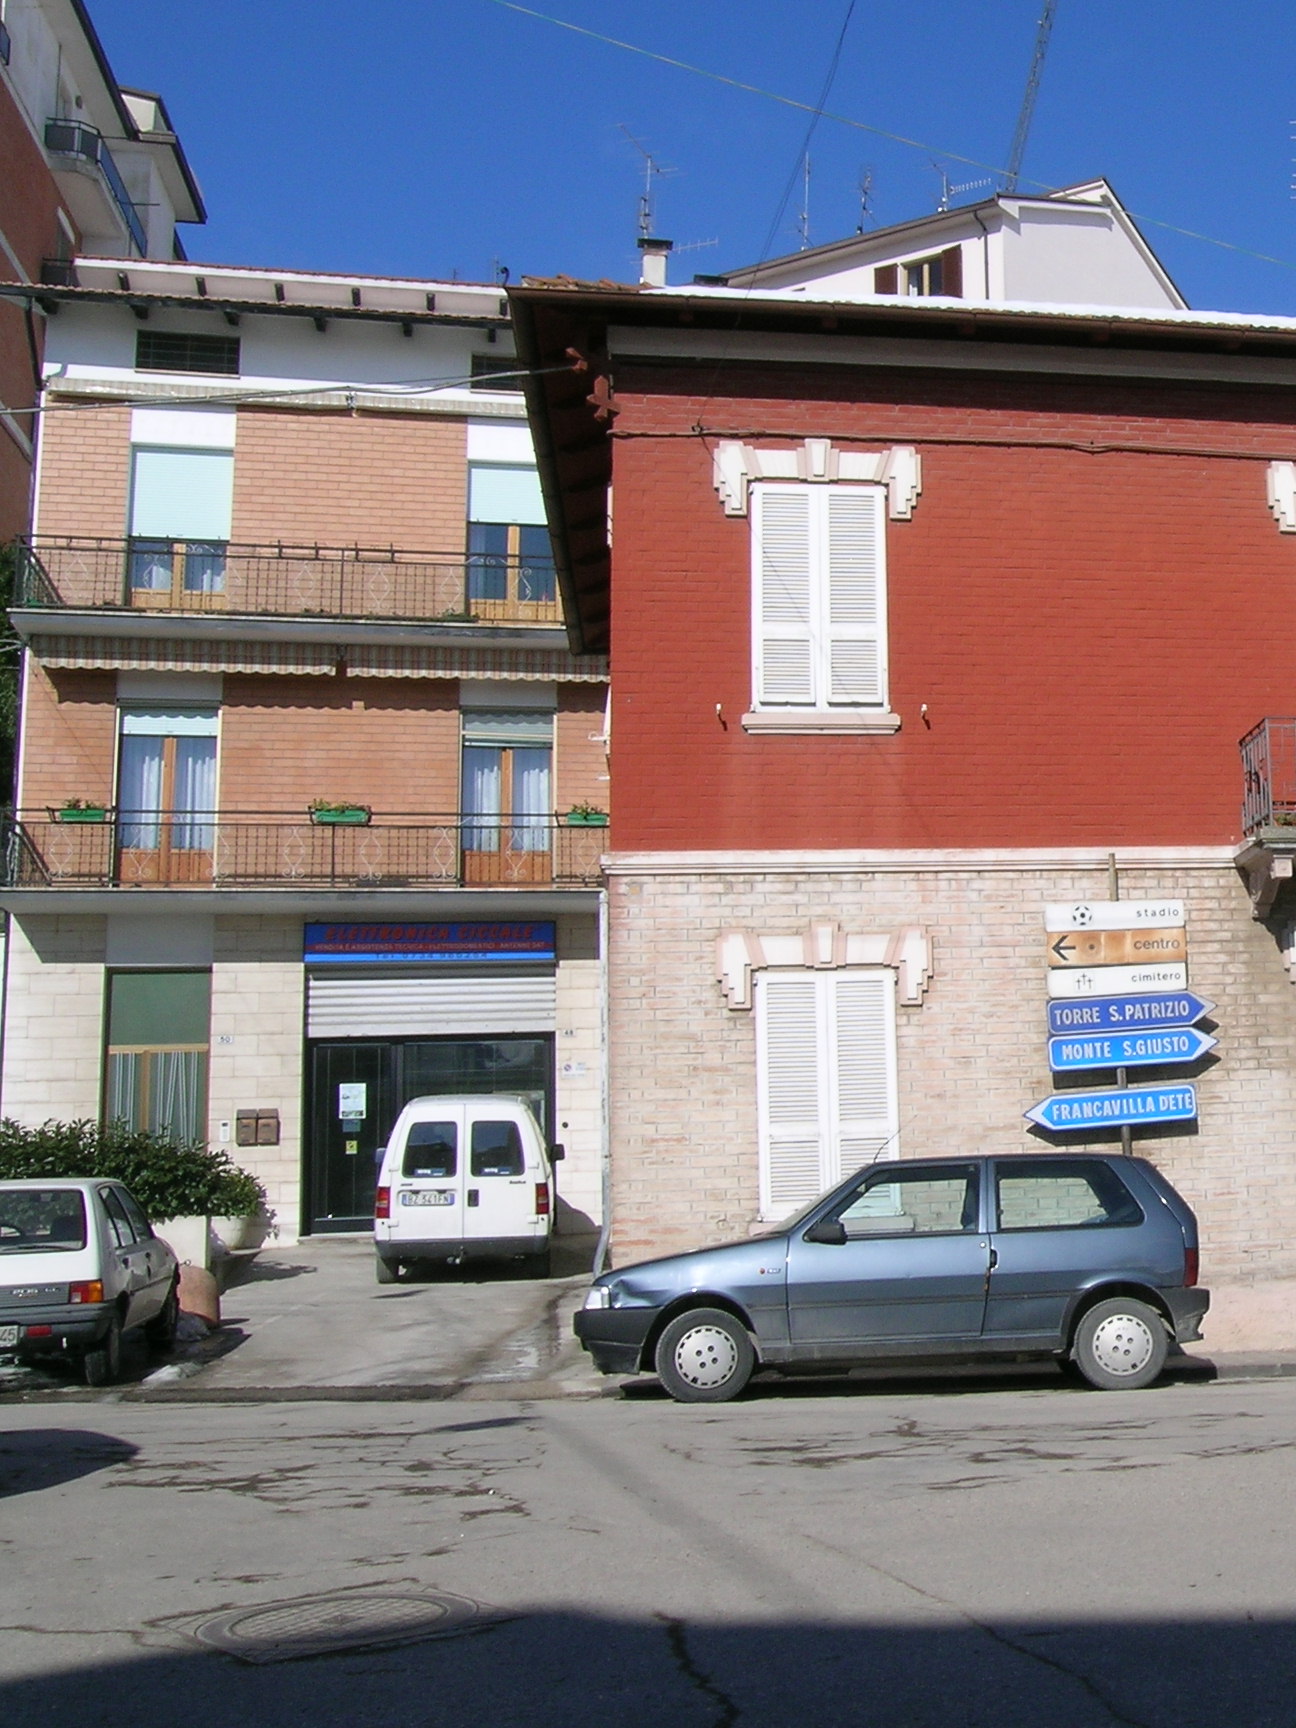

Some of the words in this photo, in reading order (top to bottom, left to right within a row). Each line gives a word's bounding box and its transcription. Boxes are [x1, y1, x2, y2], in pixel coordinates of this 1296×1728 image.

[1136, 907, 1179, 918] stadio
[326, 926, 448, 940] ELETTRONICA
[1133, 934, 1180, 949] centro
[1131, 971, 1181, 983] cimitero
[1054, 1006, 1101, 1026] TORRE
[1109, 1000, 1190, 1022] S.PATRIZIO
[1062, 1041, 1112, 1060] MONTE
[1123, 1036, 1189, 1057] S.GIUSTO
[1052, 1096, 1155, 1122] FRANCAVILLA
